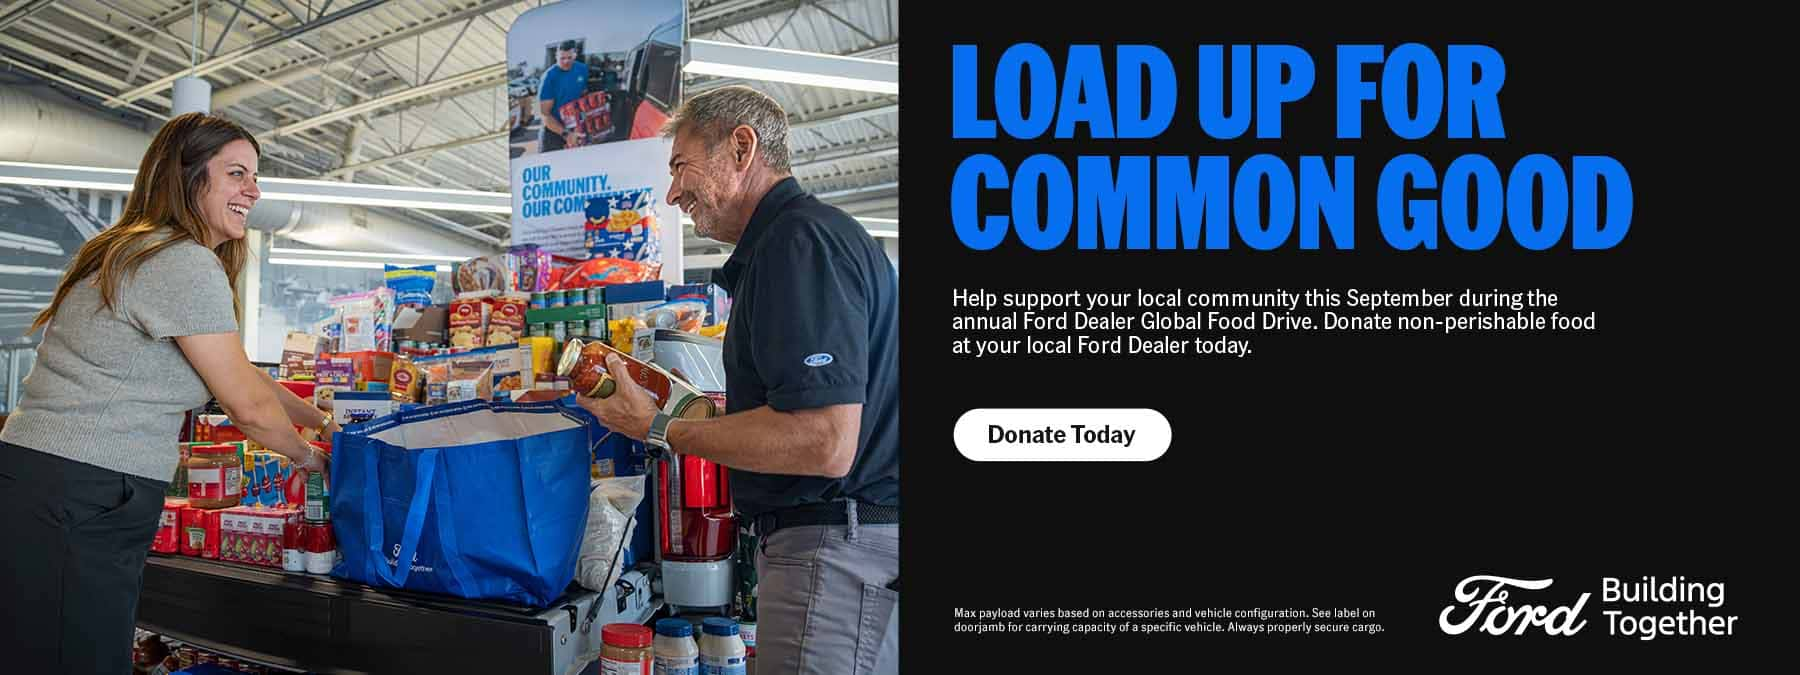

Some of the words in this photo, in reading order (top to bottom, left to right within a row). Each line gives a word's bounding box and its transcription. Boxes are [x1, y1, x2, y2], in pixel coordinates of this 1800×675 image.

[522, 165, 551, 184] OUR
[522, 174, 611, 201] COMMUNITY.
[522, 199, 550, 218] OUR
